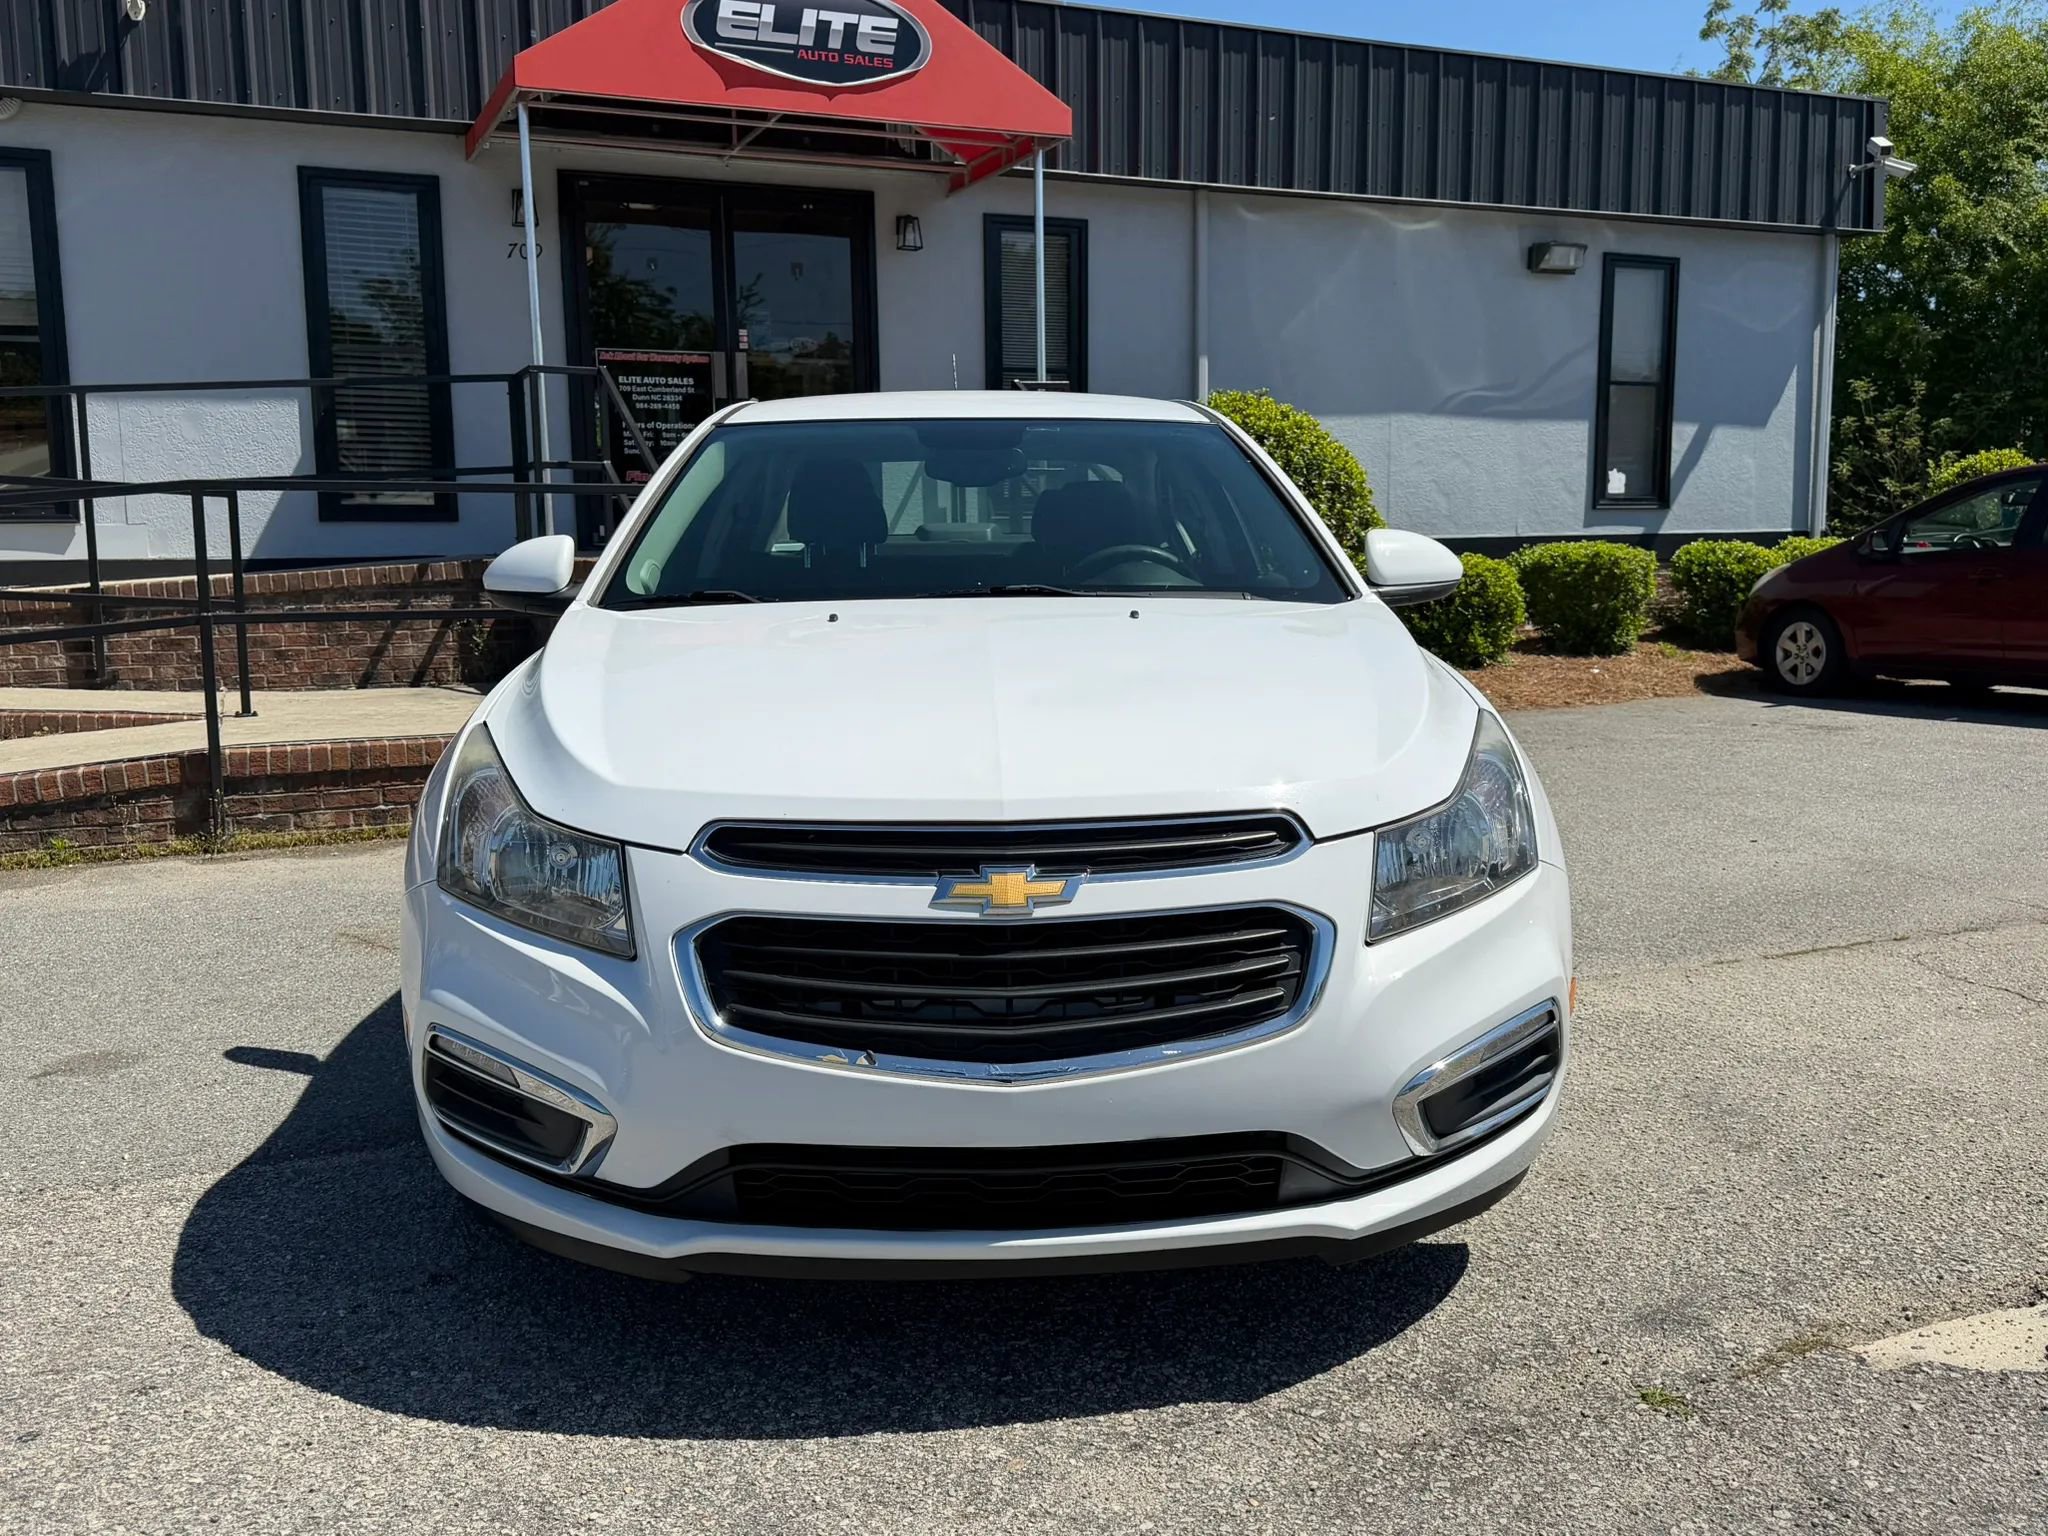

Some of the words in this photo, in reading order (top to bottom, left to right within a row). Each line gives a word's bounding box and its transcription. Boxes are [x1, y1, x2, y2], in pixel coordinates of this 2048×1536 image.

[716, 0, 899, 55] ELITE
[797, 49, 839, 63] AUTO
[844, 53, 895, 69] SALES
[643, 376, 666, 384] AUTO
[667, 377, 694, 385] SALES
[646, 421, 654, 429] of
